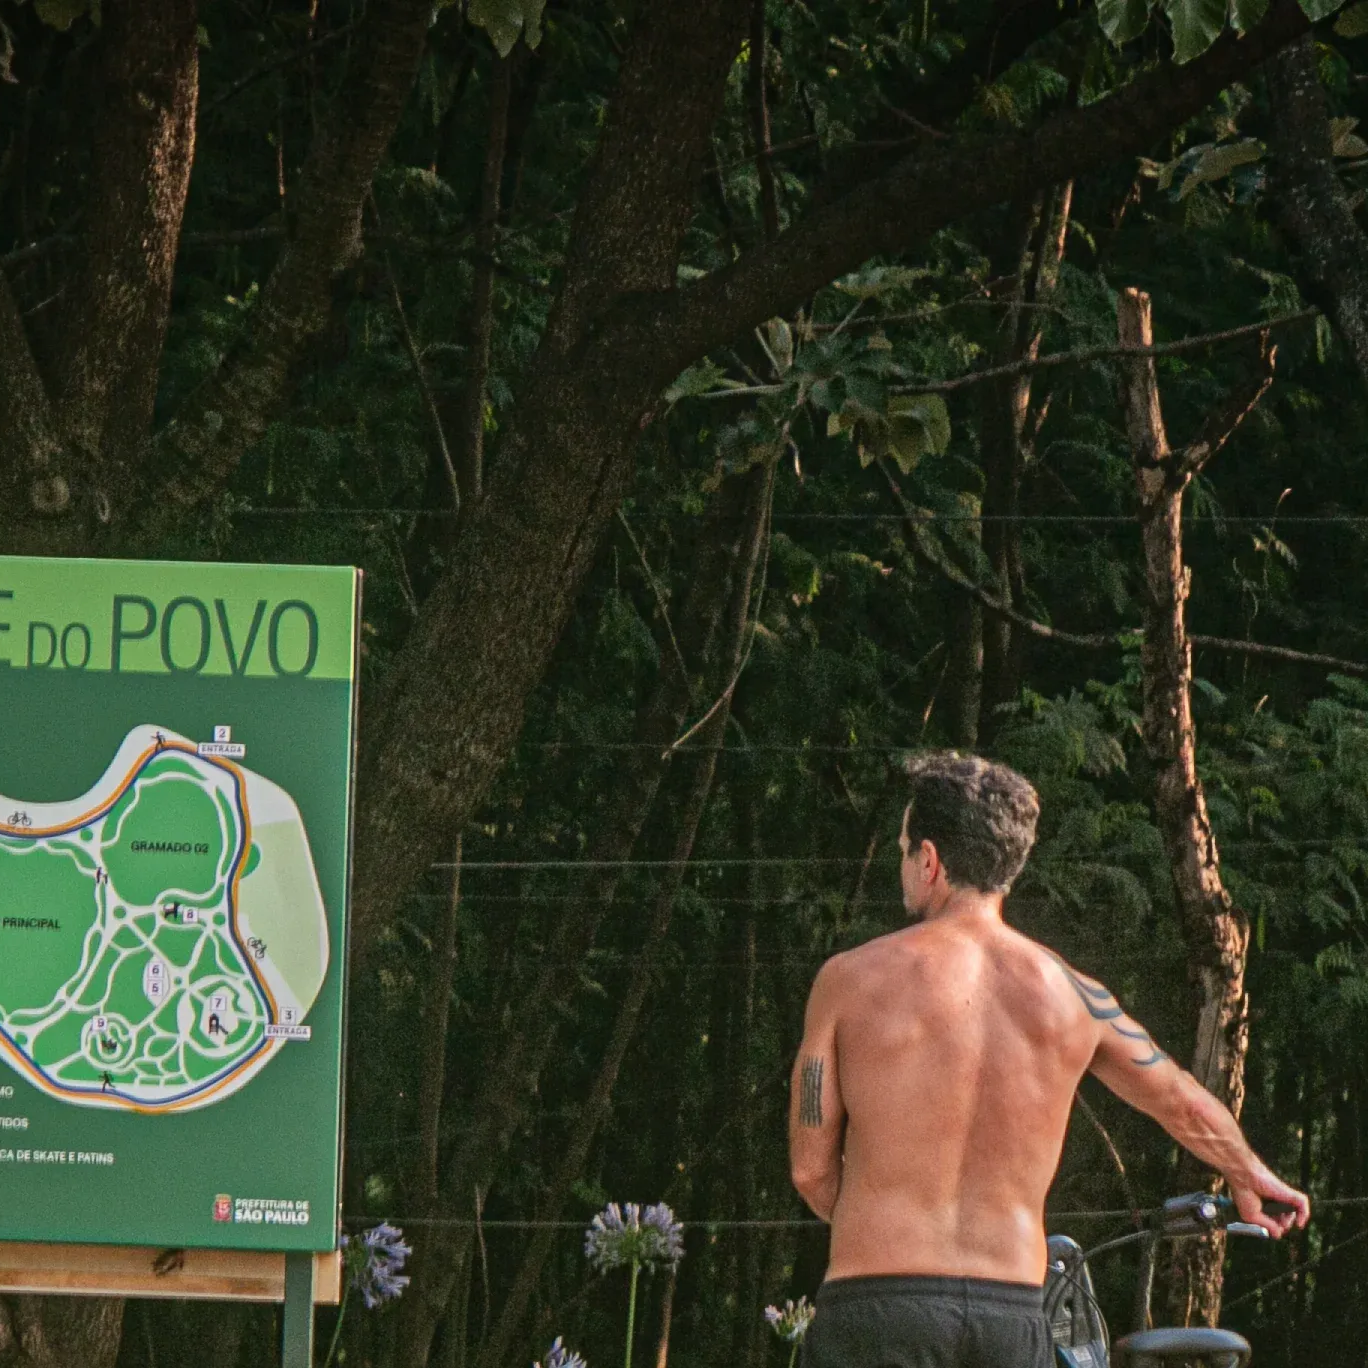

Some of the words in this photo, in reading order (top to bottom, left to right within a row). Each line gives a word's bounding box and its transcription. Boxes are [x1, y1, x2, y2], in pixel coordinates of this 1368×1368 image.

[26, 620, 92, 670] DO
[111, 594, 319, 678] POVO
[218, 728, 226, 738] 2
[201, 744, 242, 754] ENTRADA
[131, 841, 191, 853] GRAMADO
[194, 843, 208, 853] 02
[3, 917, 61, 931] PRINCIPAL
[214, 998, 222, 1008] 7
[285, 1010, 292, 1021] 3
[267, 1026, 308, 1036] ENTRADA
[17, 1149, 30, 1160] DE
[33, 1150, 66, 1162] SKATE
[68, 1152, 75, 1163] E
[77, 1152, 114, 1165] PATINS
[235, 1198, 294, 1210] PREFEITURA
[295, 1200, 309, 1210] DE
[235, 1208, 263, 1224] SÃO
[265, 1209, 310, 1225] PAULO
